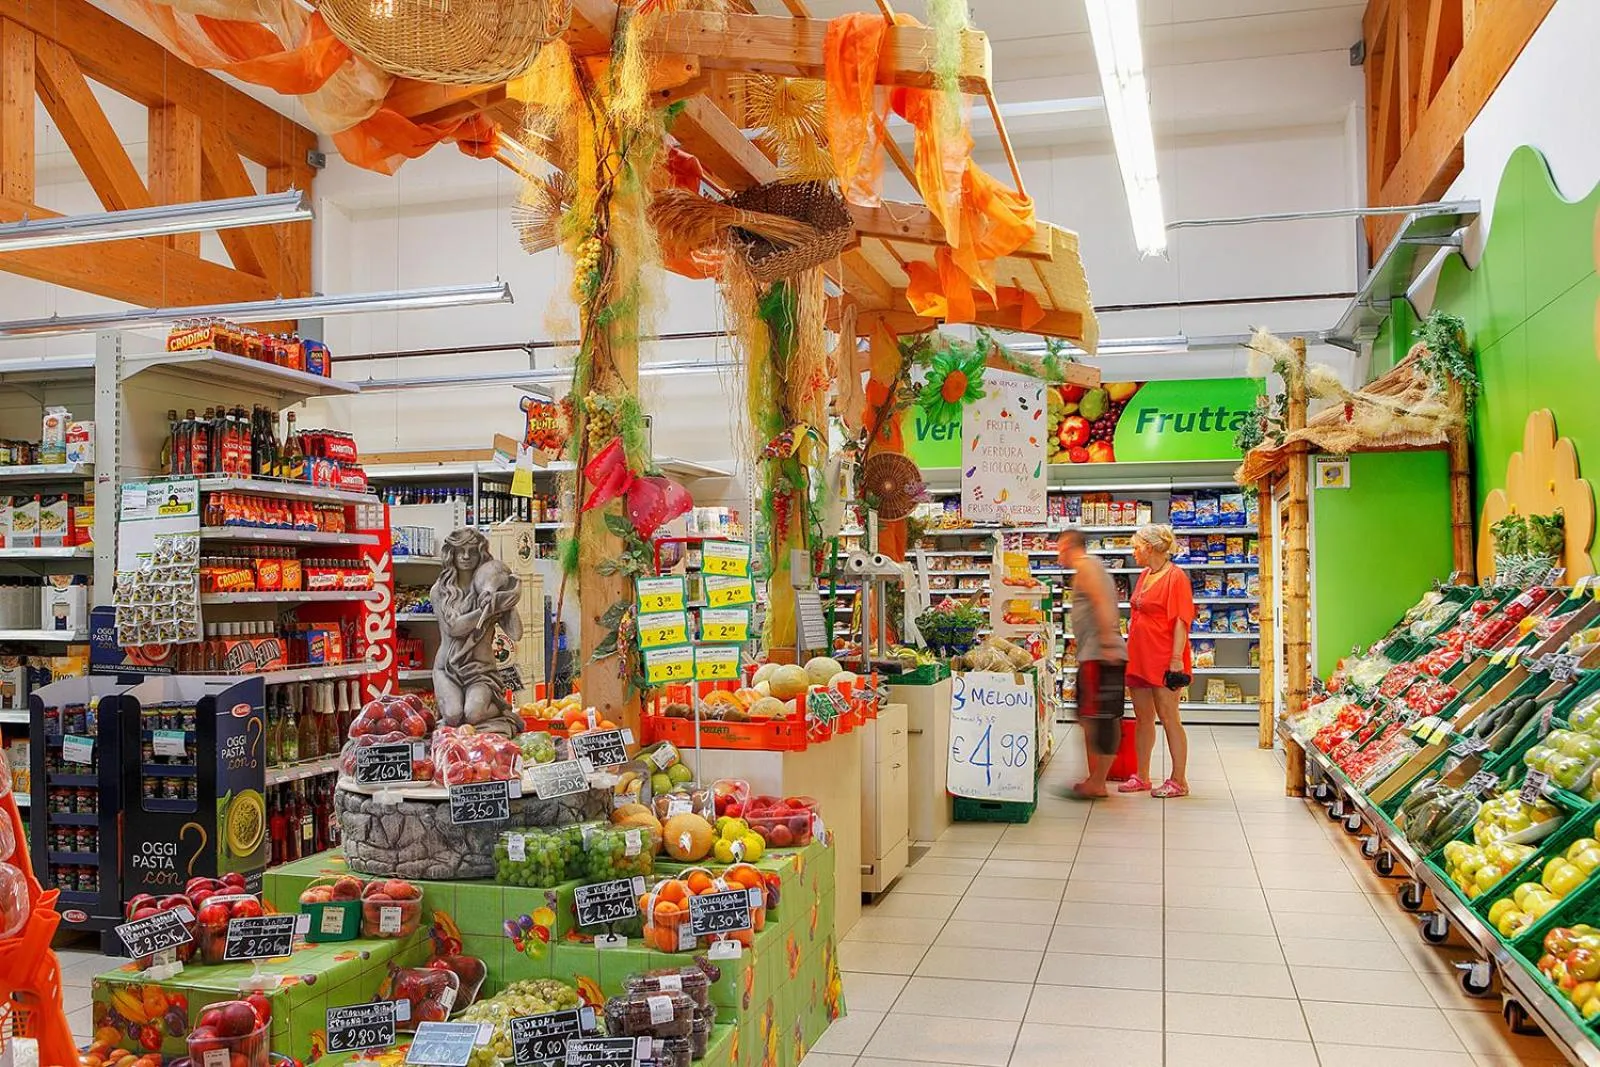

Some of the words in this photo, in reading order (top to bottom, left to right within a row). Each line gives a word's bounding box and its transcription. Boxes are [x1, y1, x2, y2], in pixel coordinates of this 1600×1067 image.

[170, 328, 210, 350] CRODINO
[916, 416, 962, 442] Ver
[986, 420, 1020, 432] FRUTTA
[1136, 406, 1250, 434] Frutta
[982, 446, 1024, 458] VERDURA
[982, 462, 1028, 474] BIOLOGICA
[968, 504, 994, 513] FRUITS
[217, 570, 252, 588] CRODINO
[92, 634, 114, 642] PASTA
[952, 676, 966, 711] 3
[971, 688, 1033, 708] MELONI
[226, 734, 248, 748] OGGI
[952, 735, 965, 764] €
[222, 746, 246, 760] PASTA
[370, 764, 396, 782] 1,60
[466, 802, 494, 820] 3,50
[141, 842, 178, 856] OGGI
[132, 854, 175, 870] PASTA
[694, 920, 706, 930] €
[134, 942, 144, 956] €
[144, 934, 170, 952] 2,50
[230, 941, 241, 956] €
[244, 938, 272, 956] 2,50
[328, 1017, 362, 1029] SPAGNA
[330, 1034, 343, 1048] €
[348, 1028, 376, 1048] 2,80
[378, 1025, 394, 1044] Kg
[517, 1044, 530, 1061] €
[532, 1040, 562, 1060] 8,00
